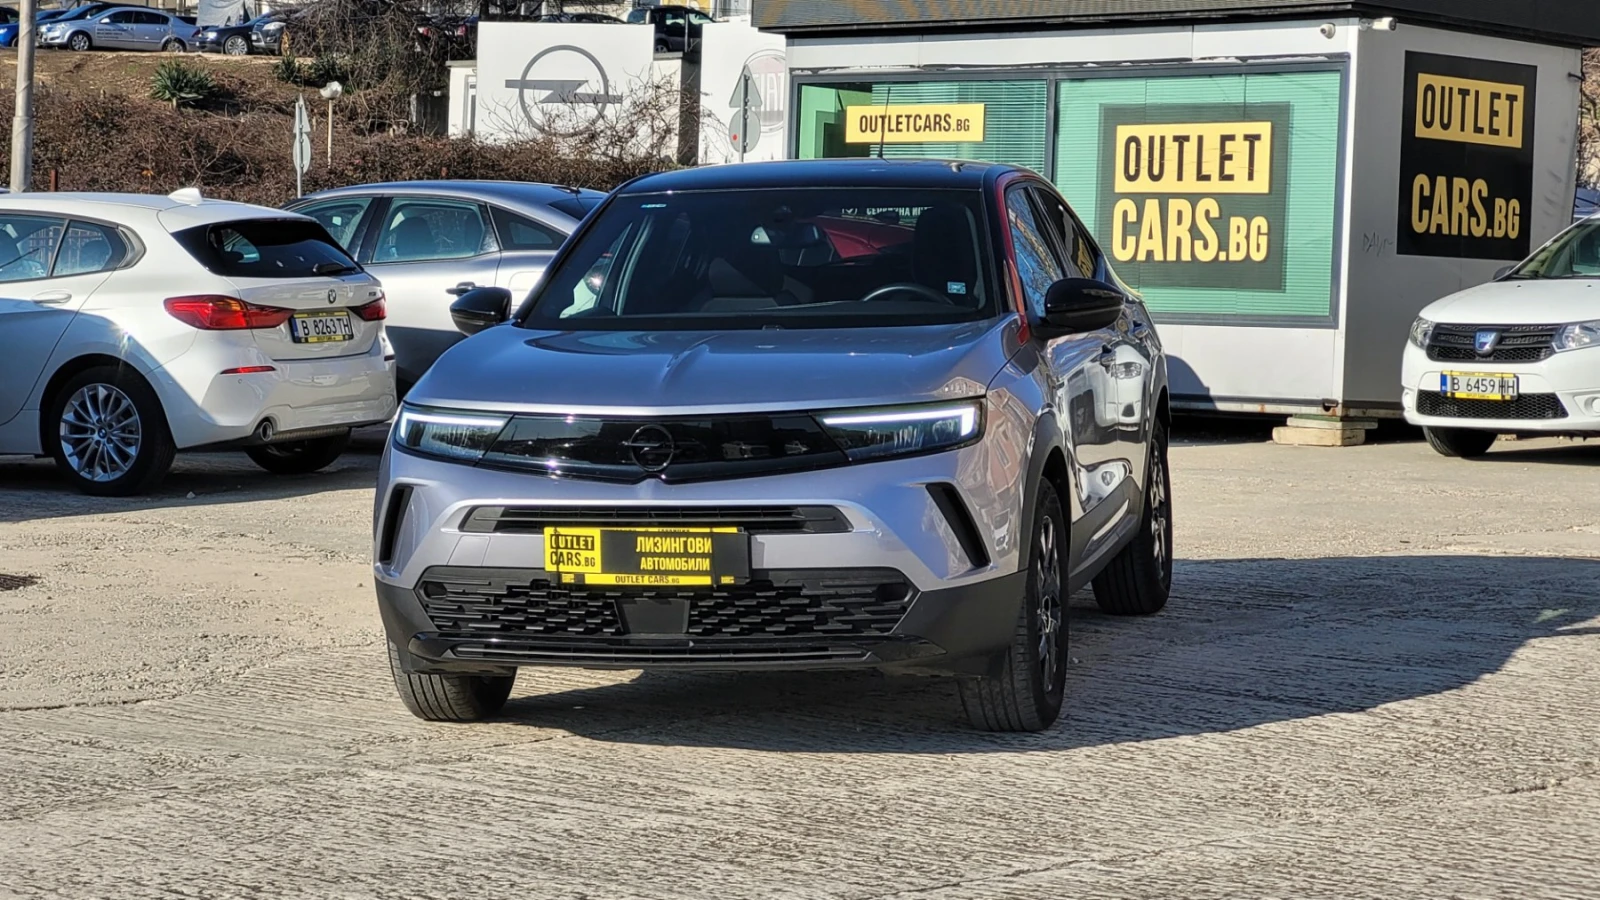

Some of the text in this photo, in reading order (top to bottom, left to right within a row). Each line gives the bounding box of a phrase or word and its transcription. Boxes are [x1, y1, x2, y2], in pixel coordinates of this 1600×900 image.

[1422, 83, 1518, 138] OUTLET
[859, 114, 970, 133] OUTLETCARS.BG
[1123, 134, 1261, 182] OUTLET
[1411, 173, 1521, 239] CARS.BG
[1112, 197, 1269, 262] CARS.BG
[301, 321, 310, 336] B
[313, 319, 337, 335] 8263
[1452, 377, 1515, 394] B 6459 HH
[636, 536, 713, 554] ЛИЗИНГОВИ
[640, 556, 711, 571] АВТОМОБИЛИ
[615, 575, 645, 584] OUTLET
